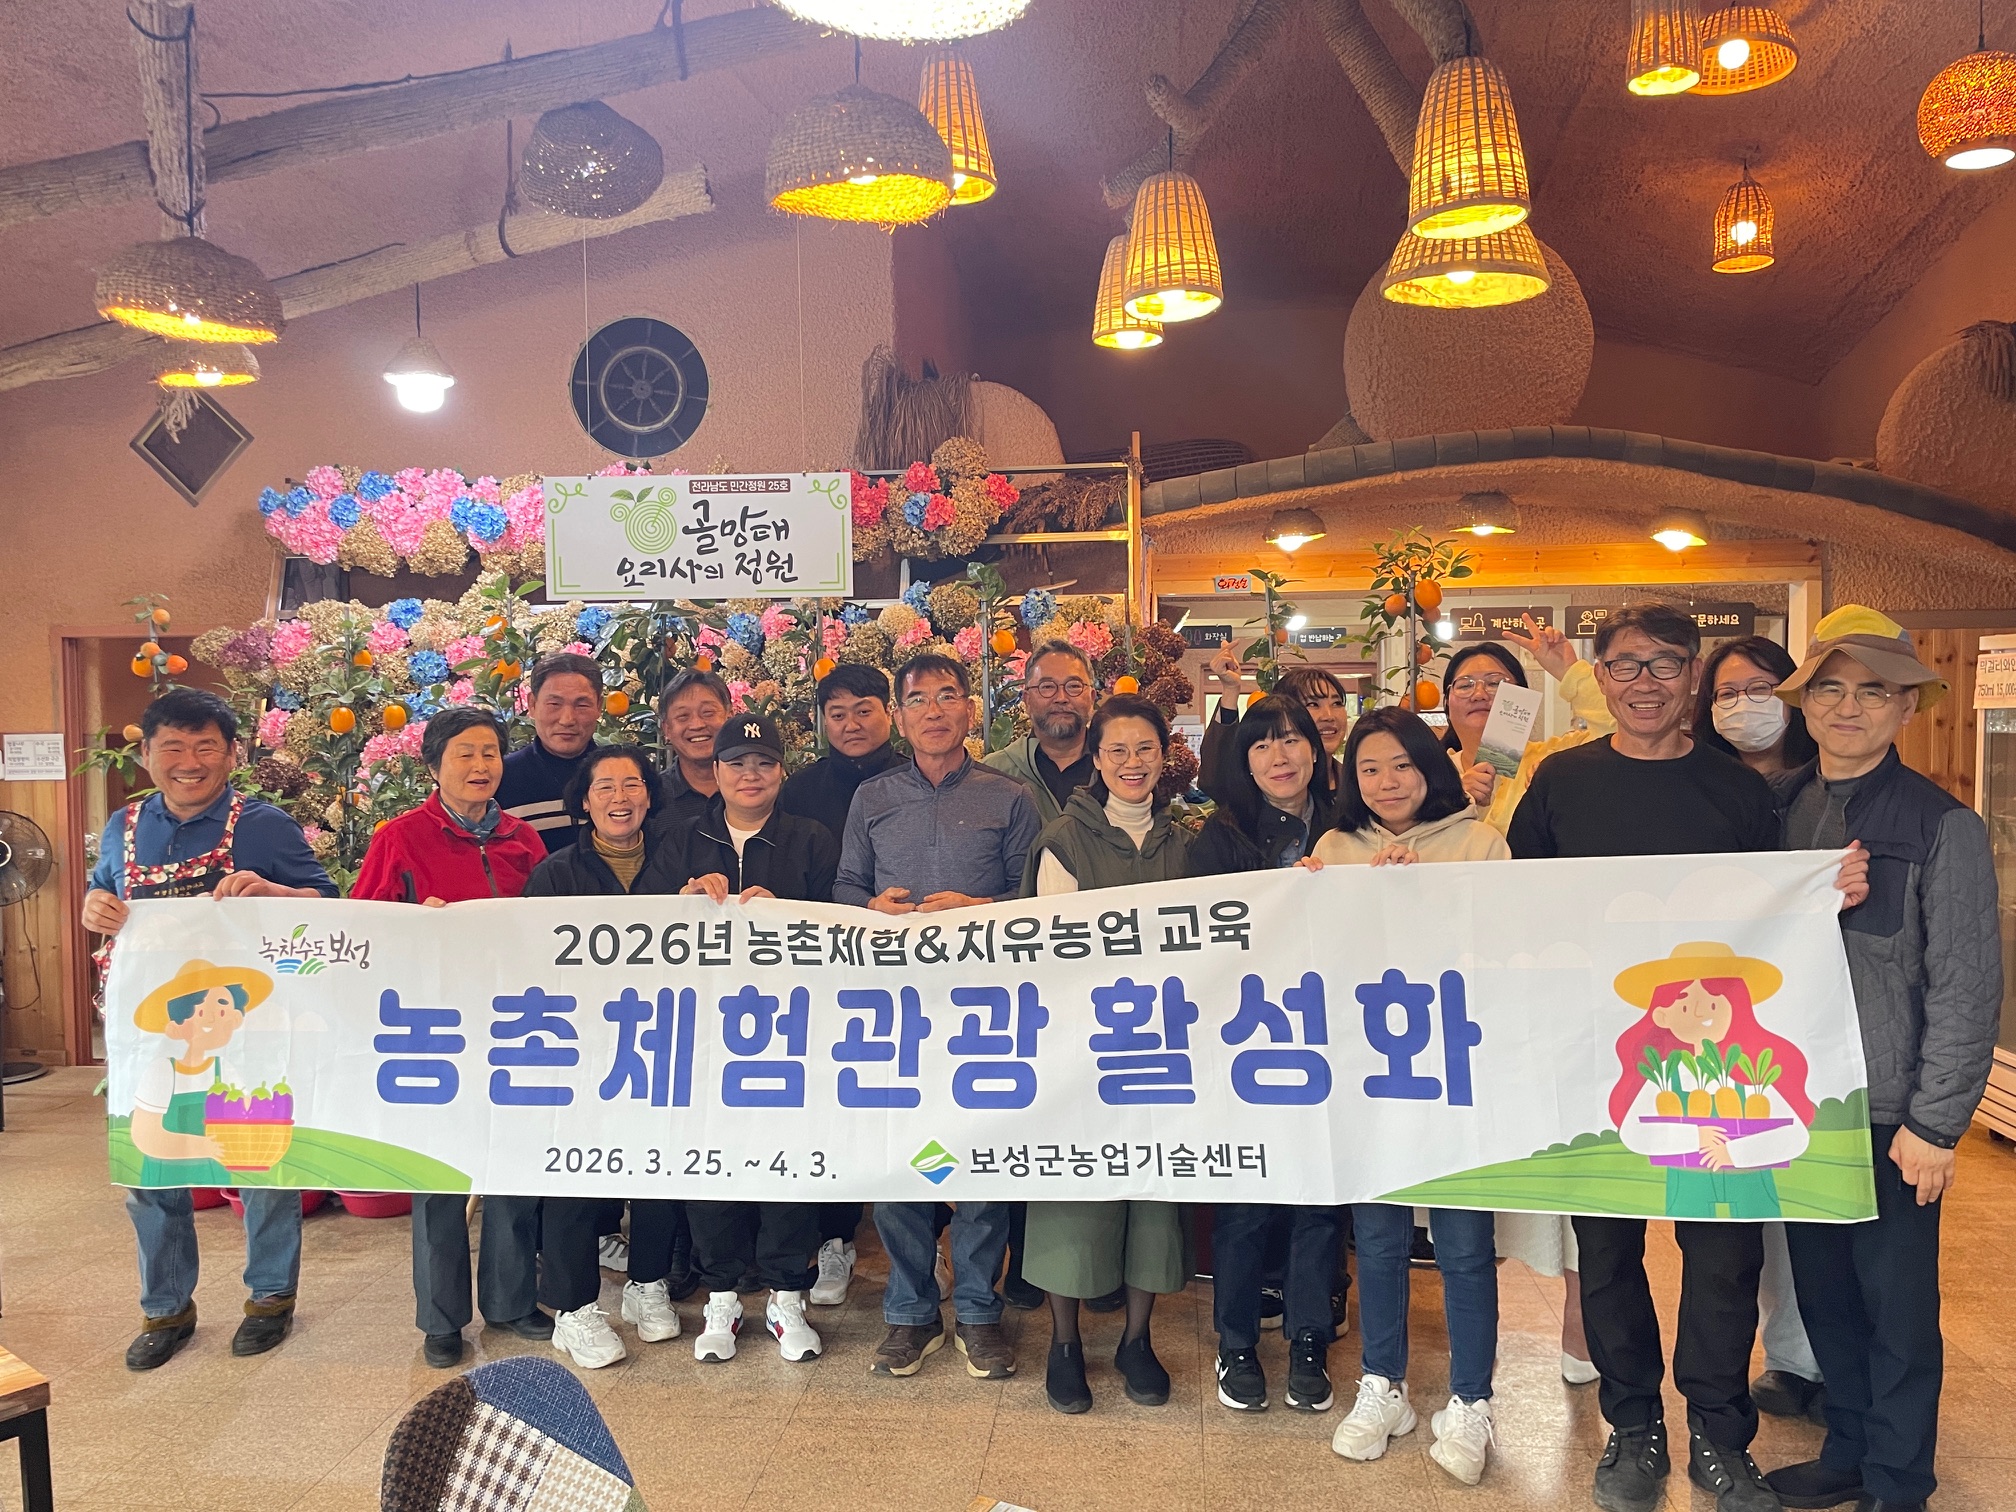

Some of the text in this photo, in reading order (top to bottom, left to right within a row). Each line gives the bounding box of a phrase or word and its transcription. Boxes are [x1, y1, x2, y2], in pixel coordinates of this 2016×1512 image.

[691, 479, 789, 492] 전라남도 민간정원 25호
[681, 499, 790, 556] 골망태
[616, 548, 798, 587] 요리사의 정원
[1204, 632, 1228, 642] 화장실
[1308, 633, 1335, 643] 반납하는
[1997, 682, 2016, 698] 15,000
[743, 722, 762, 738] NY
[259, 930, 370, 970] 녹차수도 보성
[553, 900, 1251, 967] 2026년 농촌체험&치유농업 교육
[373, 968, 1483, 1110] 농촌체험관광 활성화
[544, 1147, 633, 1176] 2026.
[644, 1148, 672, 1176] 3.
[683, 1149, 732, 1177] 25.
[809, 1151, 837, 1179] 3.
[970, 1142, 1268, 1178] 보성군농업기술센터
